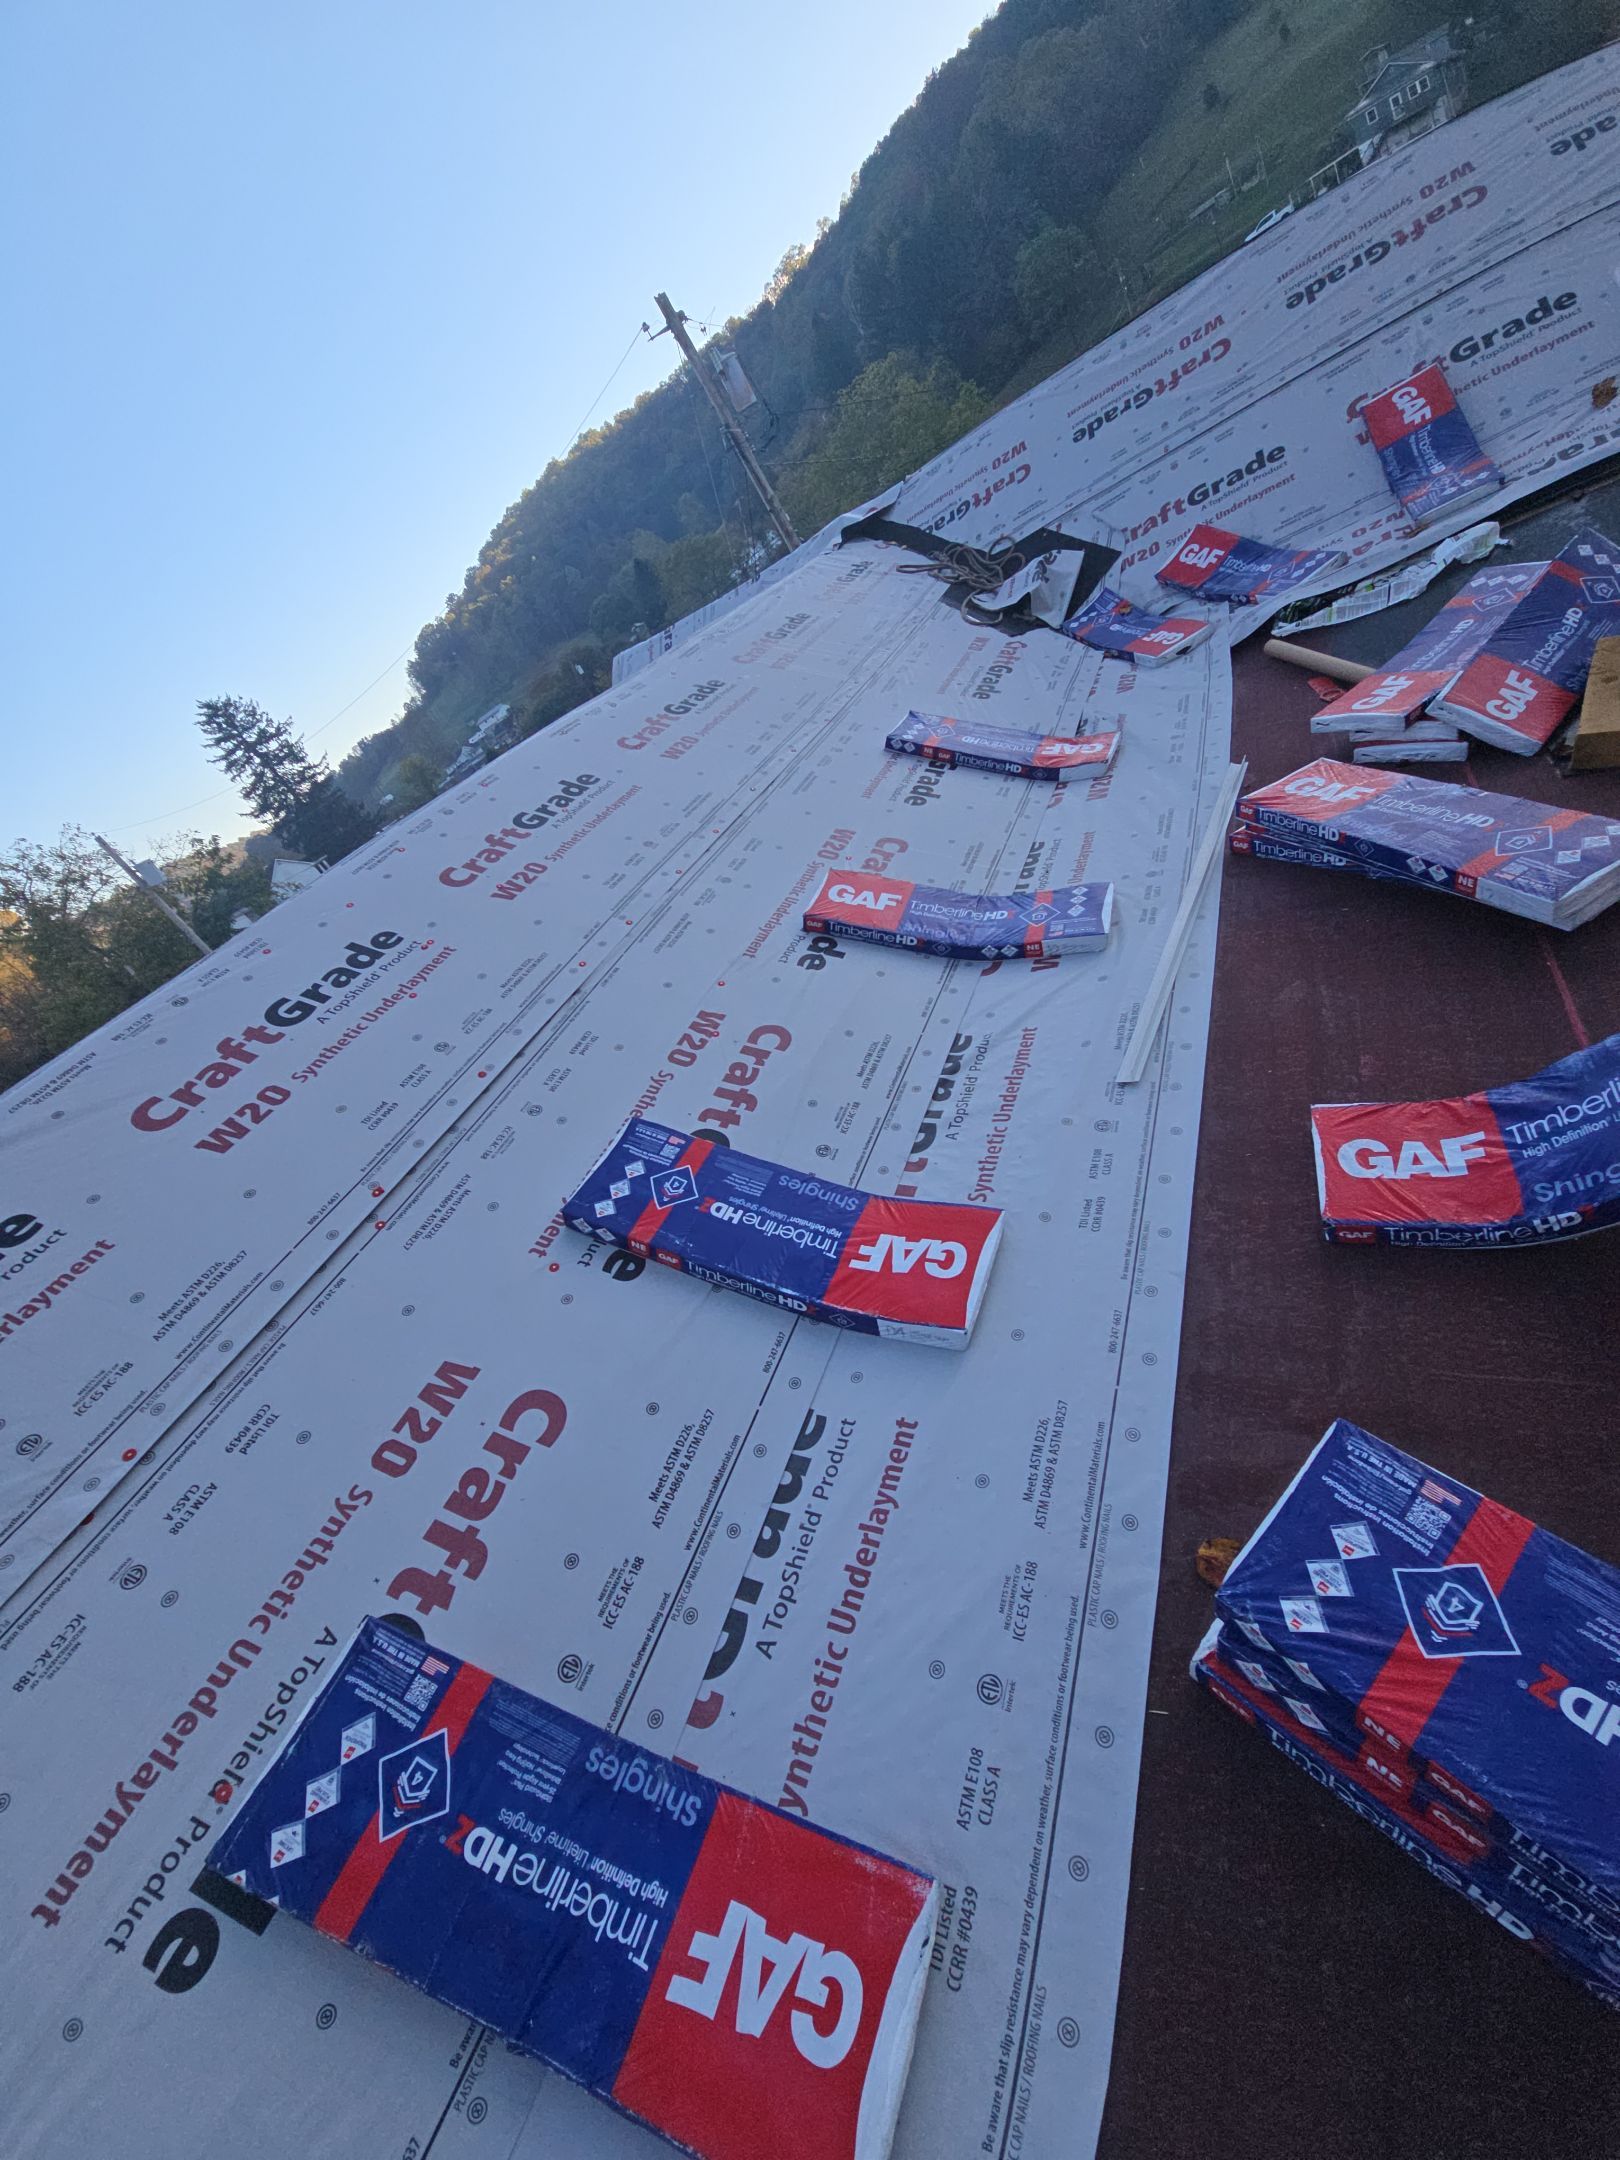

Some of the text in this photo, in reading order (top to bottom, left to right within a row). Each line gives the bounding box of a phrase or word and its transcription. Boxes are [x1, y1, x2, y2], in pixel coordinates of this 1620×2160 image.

[1420, 161, 1475, 200] W20
[1286, 185, 1488, 310] CraftGrade
[1538, 307, 1582, 333] Product
[1491, 320, 1595, 376] Underlayment
[1073, 338, 1231, 443] CraftGrade
[1392, 386, 1431, 424] GAF
[1215, 473, 1296, 521] Underlayment
[1179, 544, 1226, 569] GAF
[617, 680, 726, 750] CraftGrade
[1351, 675, 1415, 711] GAF
[1486, 670, 1538, 721] GAF
[1240, 805, 1254, 815] GAF
[1284, 777, 1377, 803] GAF
[438, 773, 601, 888] CraftGrade
[490, 784, 643, 901] W20 Synthetic Underlayment
[817, 828, 856, 860] W20
[1233, 840, 1350, 866] GAF TimberlineHD
[828, 884, 902, 911] GAF
[1458, 873, 1475, 888] NE
[742, 897, 797, 959] Underlayment
[807, 920, 823, 928] GAF
[325, 972, 380, 1018] TopShield
[381, 939, 422, 972] Product
[130, 931, 404, 1132] CraftGrade
[193, 945, 457, 1153] W20 Synthetic Underlayment
[667, 1010, 727, 1068] W20
[945, 1076, 978, 1140] A TopShield
[967, 1027, 1038, 1203] Synthetic Underlayment
[1337, 1131, 1486, 1180] GAF
[1522, 1120, 1610, 1159] High Definition
[778, 1174, 860, 1212] Shingles
[630, 1239, 647, 1251] NE
[826, 1224, 843, 1238] High
[1339, 1230, 1374, 1240] GAF
[658, 1252, 679, 1265] GAF
[849, 1233, 967, 1279] GAF
[157, 1302, 185, 1322] Meets
[181, 1280, 205, 1305] ASTM
[102, 1361, 134, 1392] AC-188
[762, 1331, 786, 1374] 800-247-6637
[224, 1403, 271, 1454] CCRR #0439
[371, 1360, 482, 1478] W20
[1054, 1399, 1070, 1429] D8257
[649, 1423, 697, 1502] Meets ASTM D226,
[1022, 1417, 1051, 1503] Meets ASTM D226,
[1048, 1430, 1063, 1457] ASTM
[651, 1500, 672, 1530] ASTM
[665, 1470, 684, 1501] D4869
[683, 1435, 702, 1463] ASTM
[696, 1408, 716, 1436] D8257
[684, 1434, 741, 1552] www.ContinentalMaterials.com
[1040, 1466, 1056, 1502] D4869
[1080, 1421, 1105, 1549] www.ContinentalMaterials.com
[169, 1482, 219, 1535] ASTM E108
[1034, 1502, 1049, 1530] ASTM
[248, 1484, 374, 1634] Synthetic
[755, 1418, 856, 1660] A TopShield Product
[602, 1555, 645, 1630] ICC-ES AC-188
[1012, 1560, 1039, 1642] ICC-ES AC-188
[1069, 1594, 1079, 1616] used.
[314, 1626, 338, 1646] A
[778, 1417, 918, 1817] ynthetic Underlayment
[1064, 1616, 1077, 1643] being
[12, 1613, 86, 1693] ICC-ES AC-188
[1058, 1643, 1073, 1681] footwear
[1003, 1680, 1017, 1713] Intertek
[1048, 1693, 1064, 1745] conditions
[1363, 1716, 1401, 1750] NE
[30, 1638, 262, 1930] Underlayment
[585, 1746, 702, 1828] Shingles
[957, 1747, 984, 1831] ASTM E108
[1044, 1747, 1058, 1784] surface
[1366, 1756, 1403, 1788] NE
[978, 1766, 1001, 1827] CLASS A
[1037, 1778, 1051, 1830] weather,
[1431, 1771, 1487, 1815] GAF
[1432, 1808, 1487, 1848] GAF
[498, 1807, 669, 1909] High Definition Lifetime Shingles
[1025, 1848, 1043, 1908] dependent
[104, 1815, 210, 1955] Product
[937, 1885, 958, 1939] Listed
[1023, 1910, 1035, 1940] vary
[947, 1886, 979, 1993] CCRR #0439
[1018, 1940, 1030, 1968] may
[664, 1899, 864, 2070] GAF
[1007, 1968, 1024, 2034] resistance
[1000, 2036, 1015, 2057] slip
[995, 2059, 1009, 2089] that
[988, 2090, 1003, 2133] aware
[981, 2134, 995, 2153] Be
